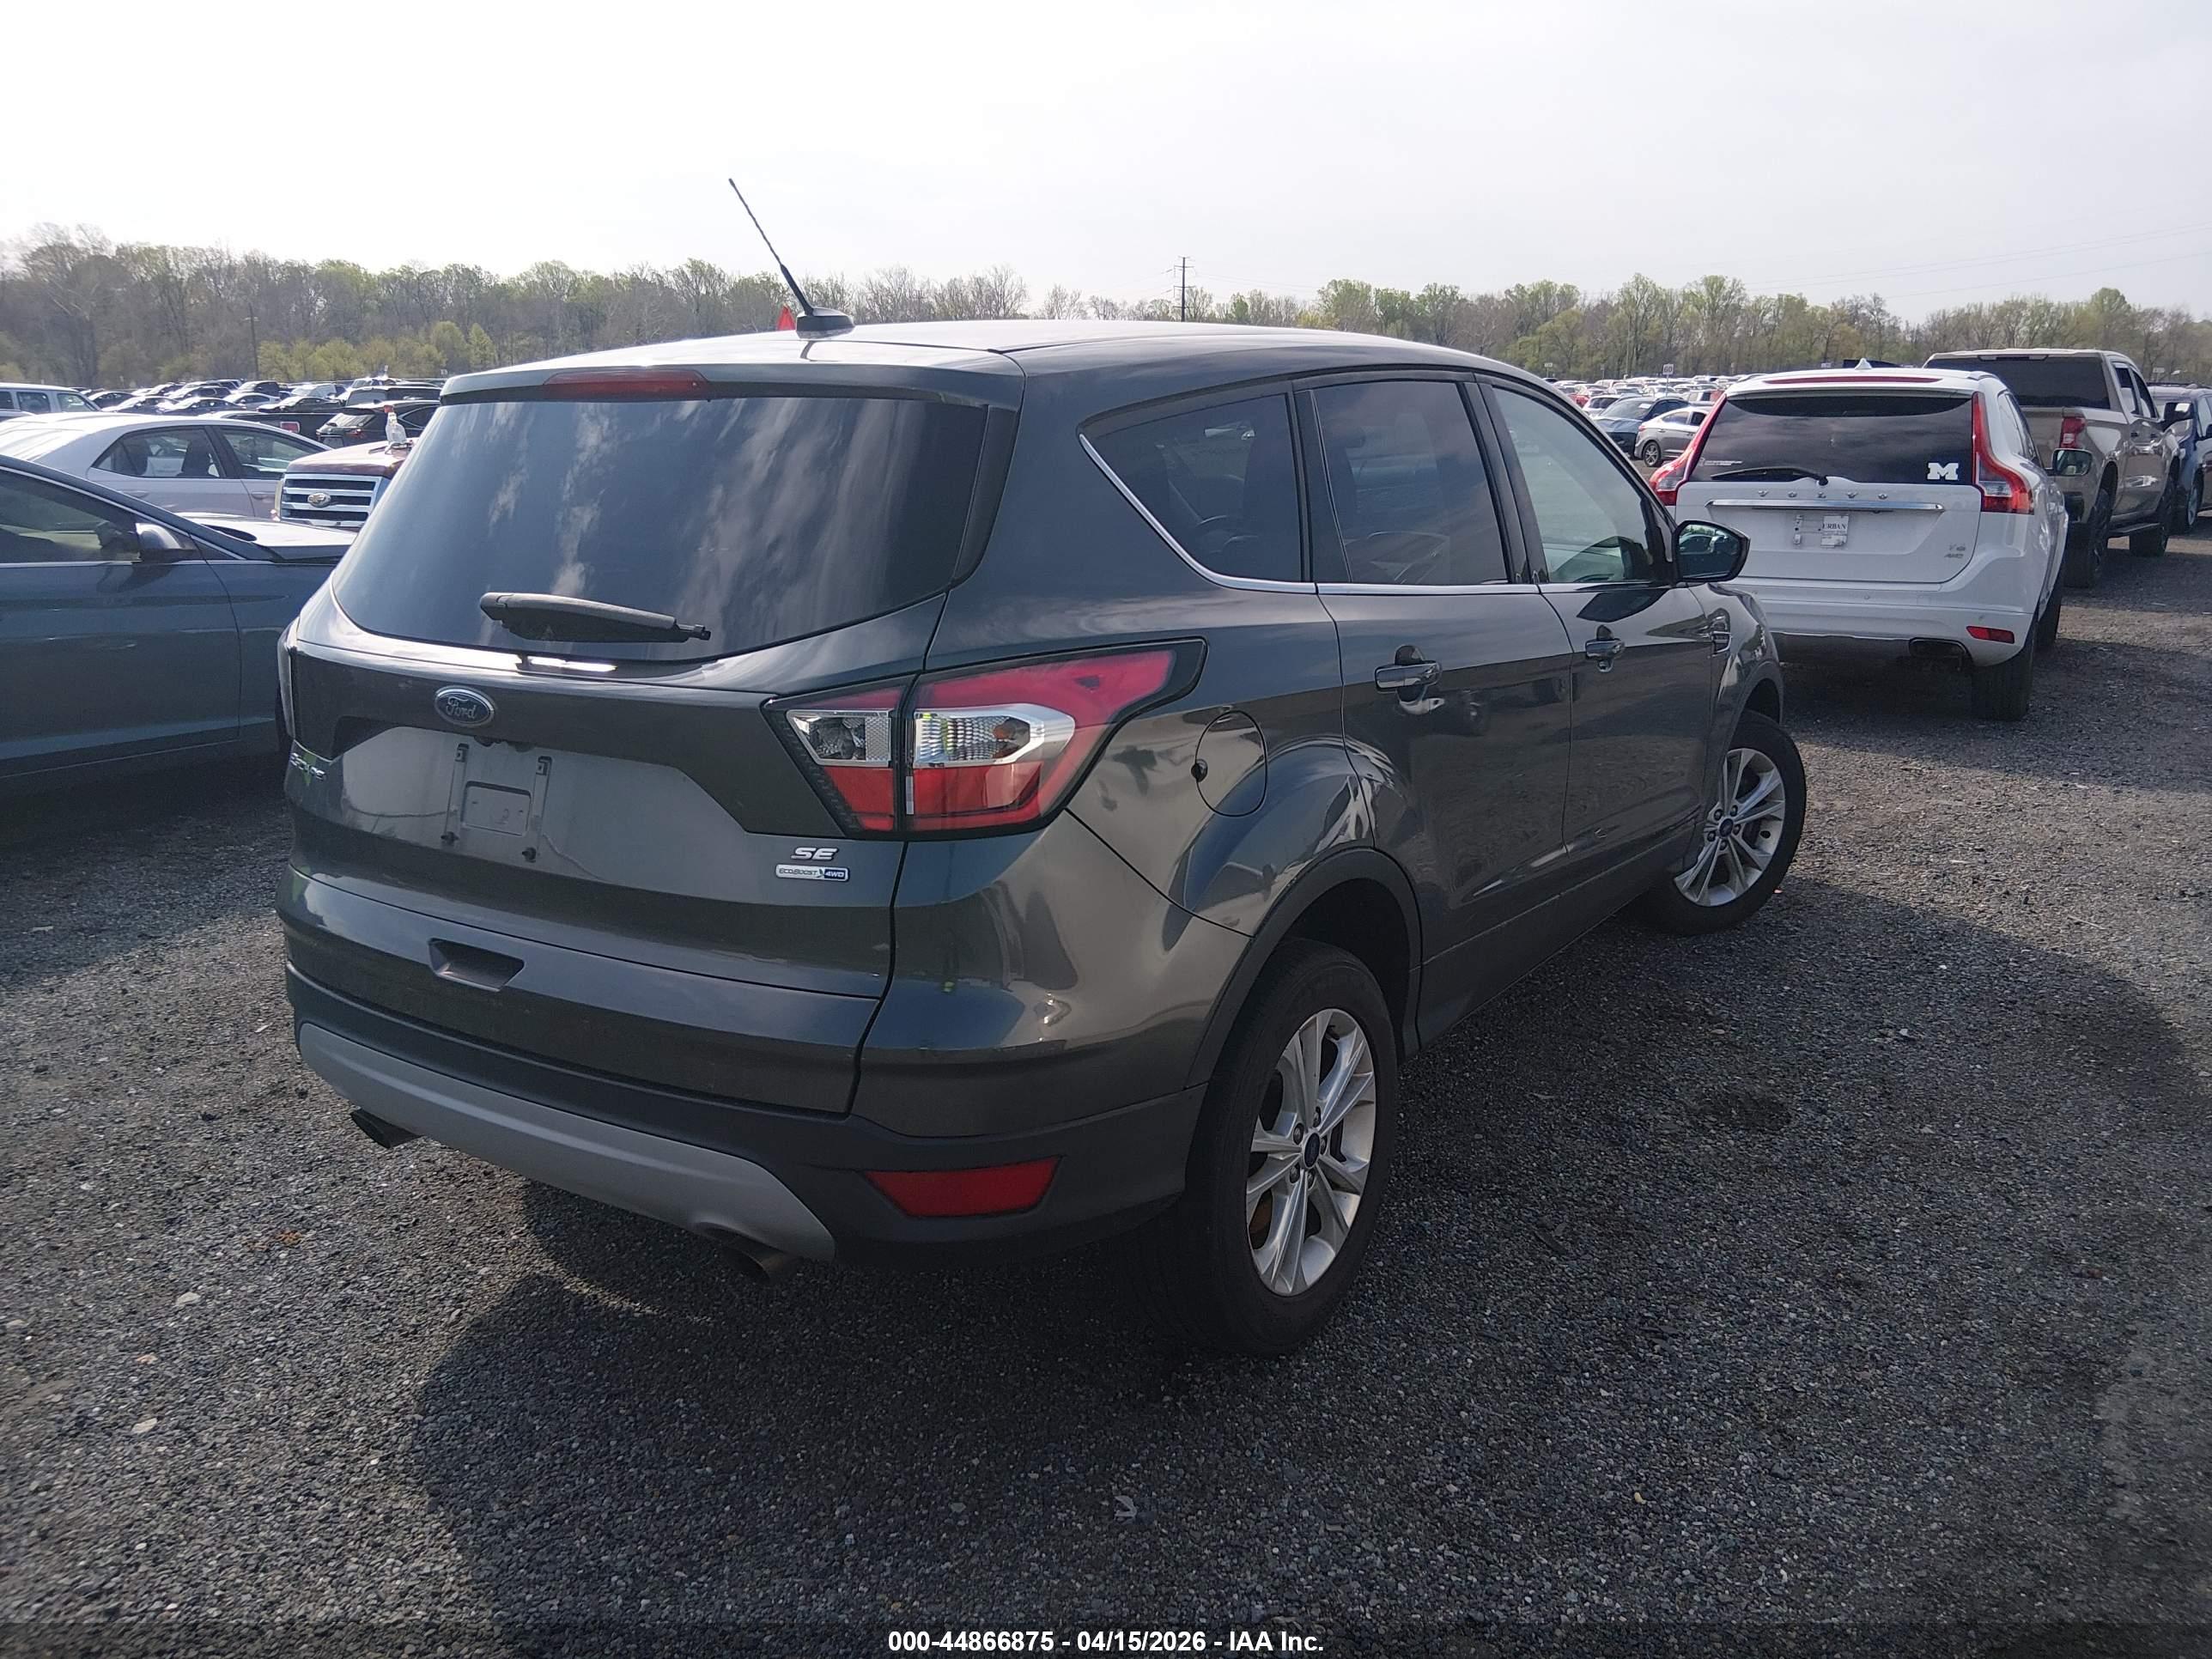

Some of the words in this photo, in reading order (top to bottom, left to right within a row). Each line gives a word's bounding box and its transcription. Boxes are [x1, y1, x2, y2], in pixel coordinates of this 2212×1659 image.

[1927, 462, 1959, 480] M
[447, 696, 477, 719] Ford
[790, 847, 838, 860] SE
